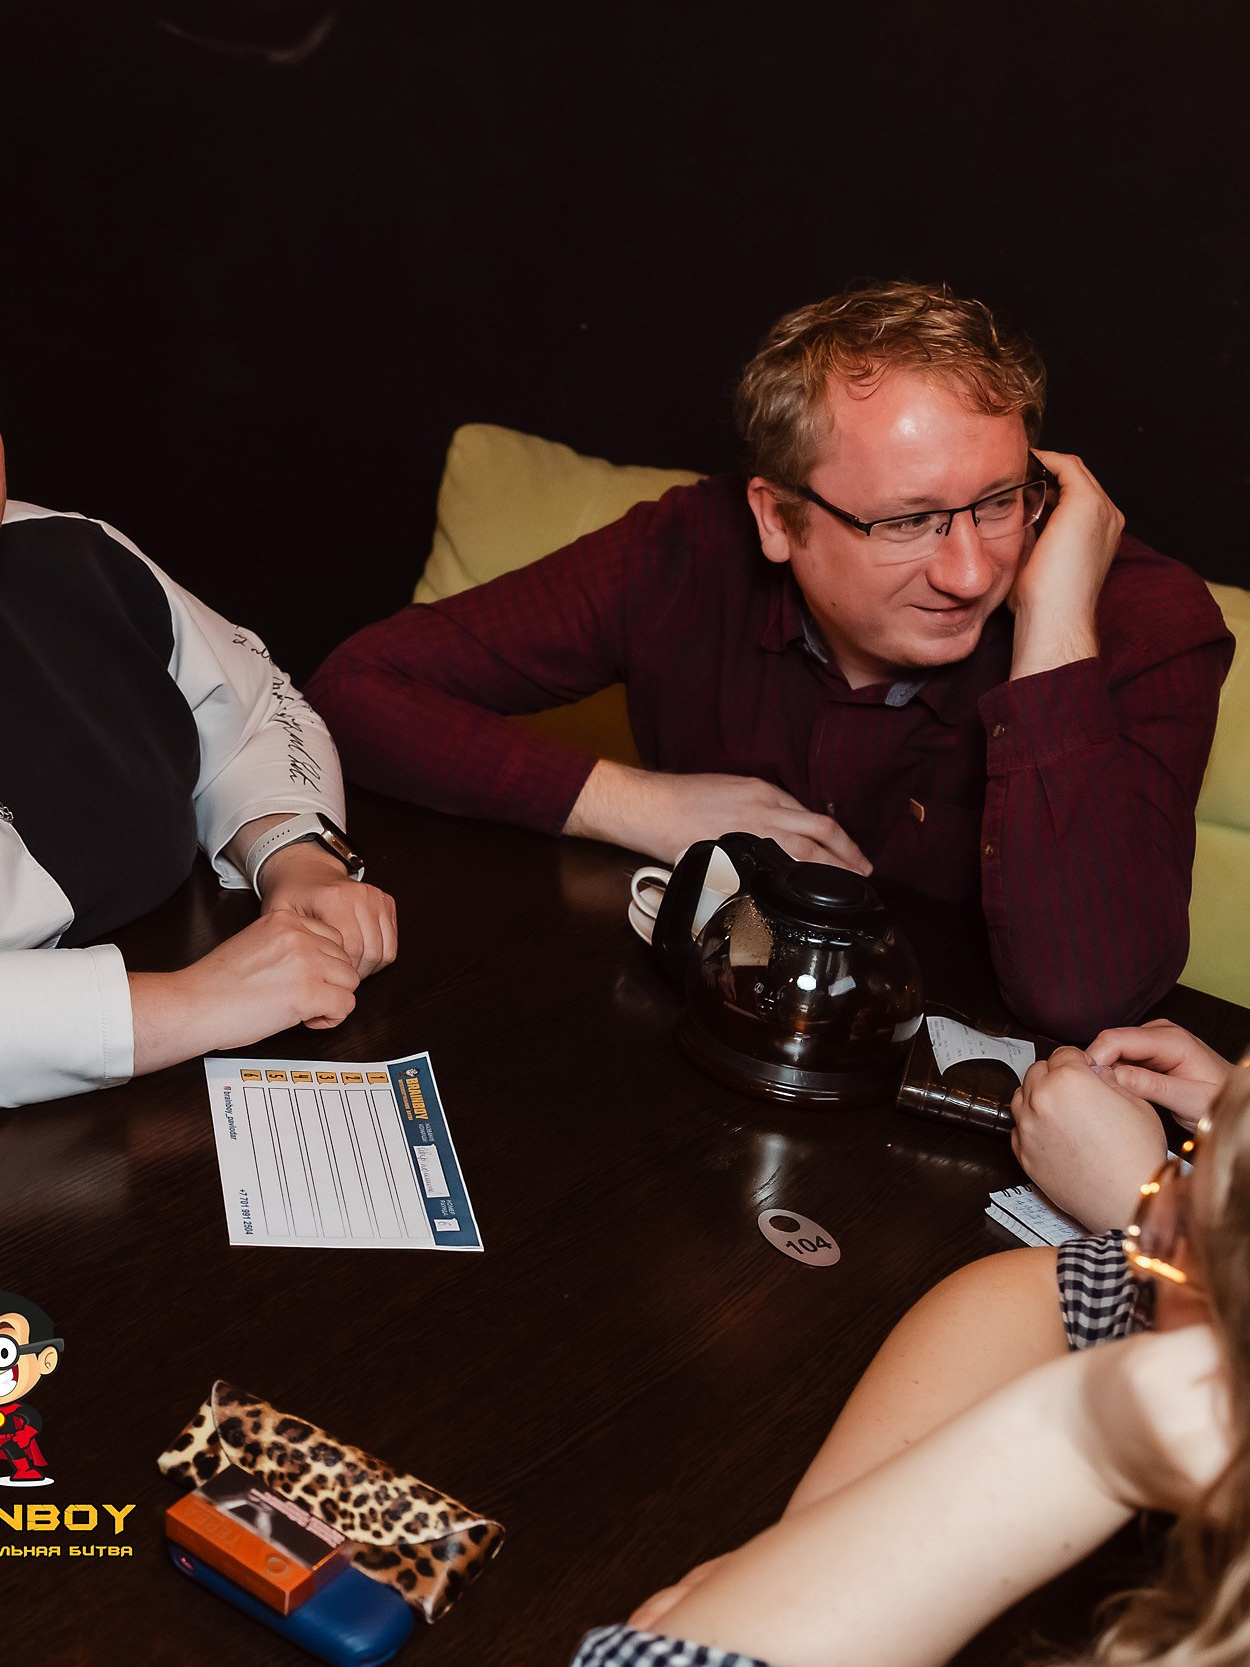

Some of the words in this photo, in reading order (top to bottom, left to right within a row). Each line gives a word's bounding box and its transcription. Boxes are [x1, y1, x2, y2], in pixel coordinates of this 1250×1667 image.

[405, 1077, 429, 1120] BRAINBOY
[223, 1091, 237, 1140] brainboy_pavlodar
[239, 1189, 248, 1197] +7
[240, 1197, 250, 1208] 701
[241, 1209, 251, 1220] 991
[243, 1221, 254, 1236] 2504
[785, 1235, 833, 1255] 104
